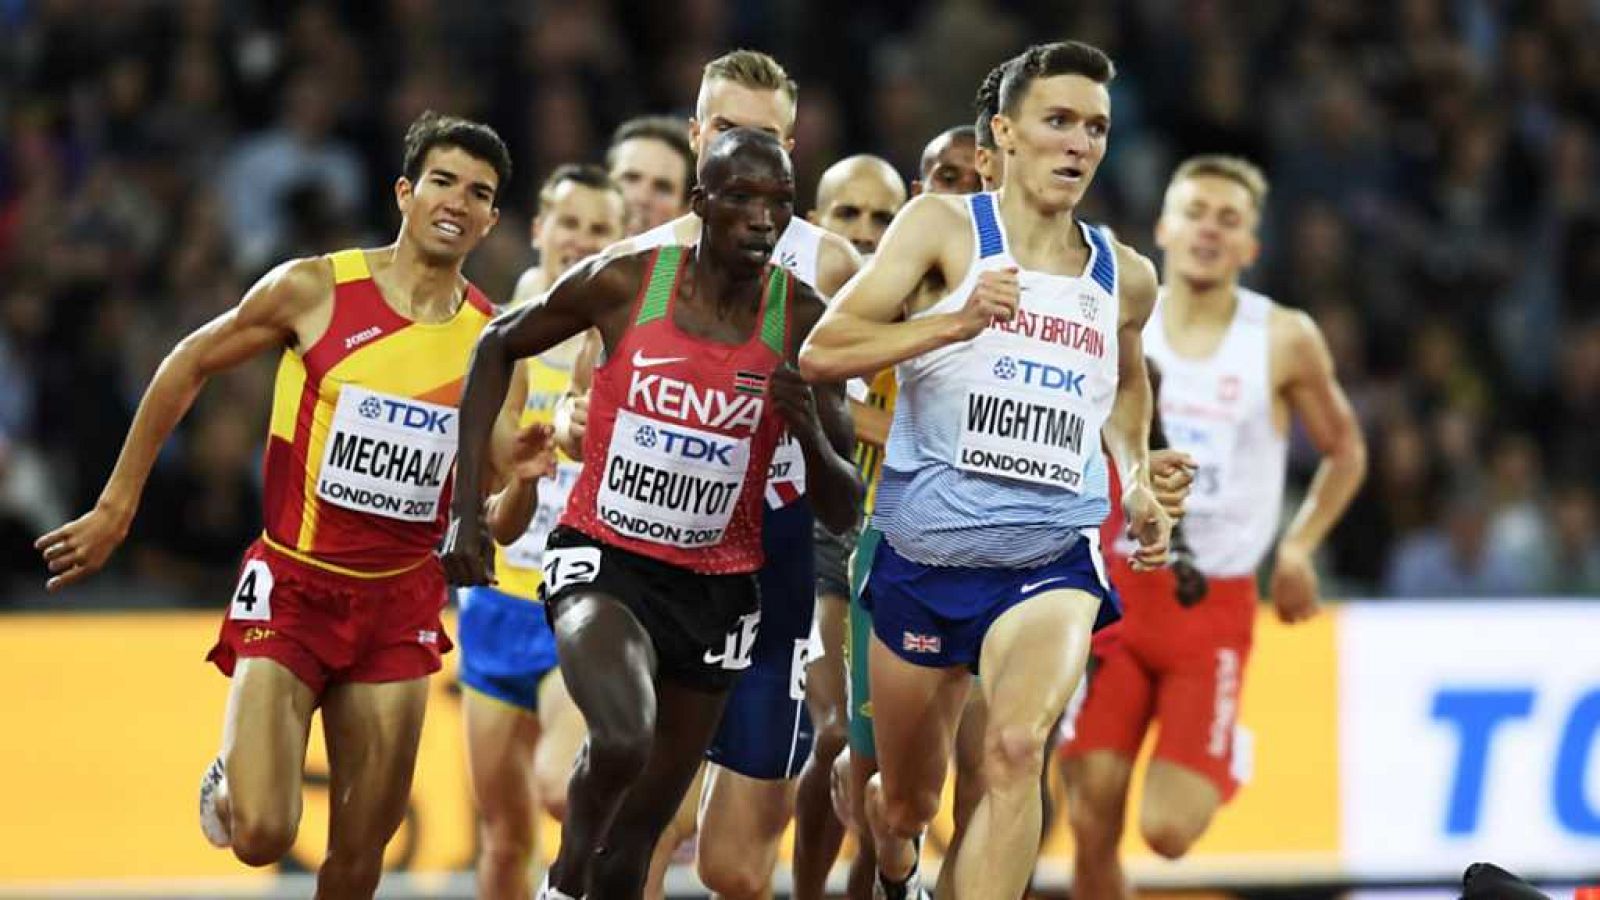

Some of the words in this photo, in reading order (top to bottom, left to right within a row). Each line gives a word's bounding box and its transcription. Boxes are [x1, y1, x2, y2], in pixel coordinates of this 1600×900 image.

[984, 308, 1040, 337] REAT
[1041, 315, 1105, 359] BRITAIN
[1017, 359, 1086, 397] TDK
[382, 400, 453, 434] TDK
[627, 371, 764, 434] KENYA
[967, 392, 1086, 455] WIGHTMAN
[328, 431, 445, 488] MECHAAL
[659, 429, 738, 467] TDK
[961, 448, 1048, 479] LONDON
[1049, 463, 1081, 487] 207
[320, 479, 402, 512] LONDON
[402, 501, 435, 517] 2017
[608, 455, 738, 516] CHERUIYOT
[600, 505, 683, 544] LONDON
[683, 527, 723, 545] 2017
[236, 568, 257, 612] 4
[544, 556, 595, 587] 12
